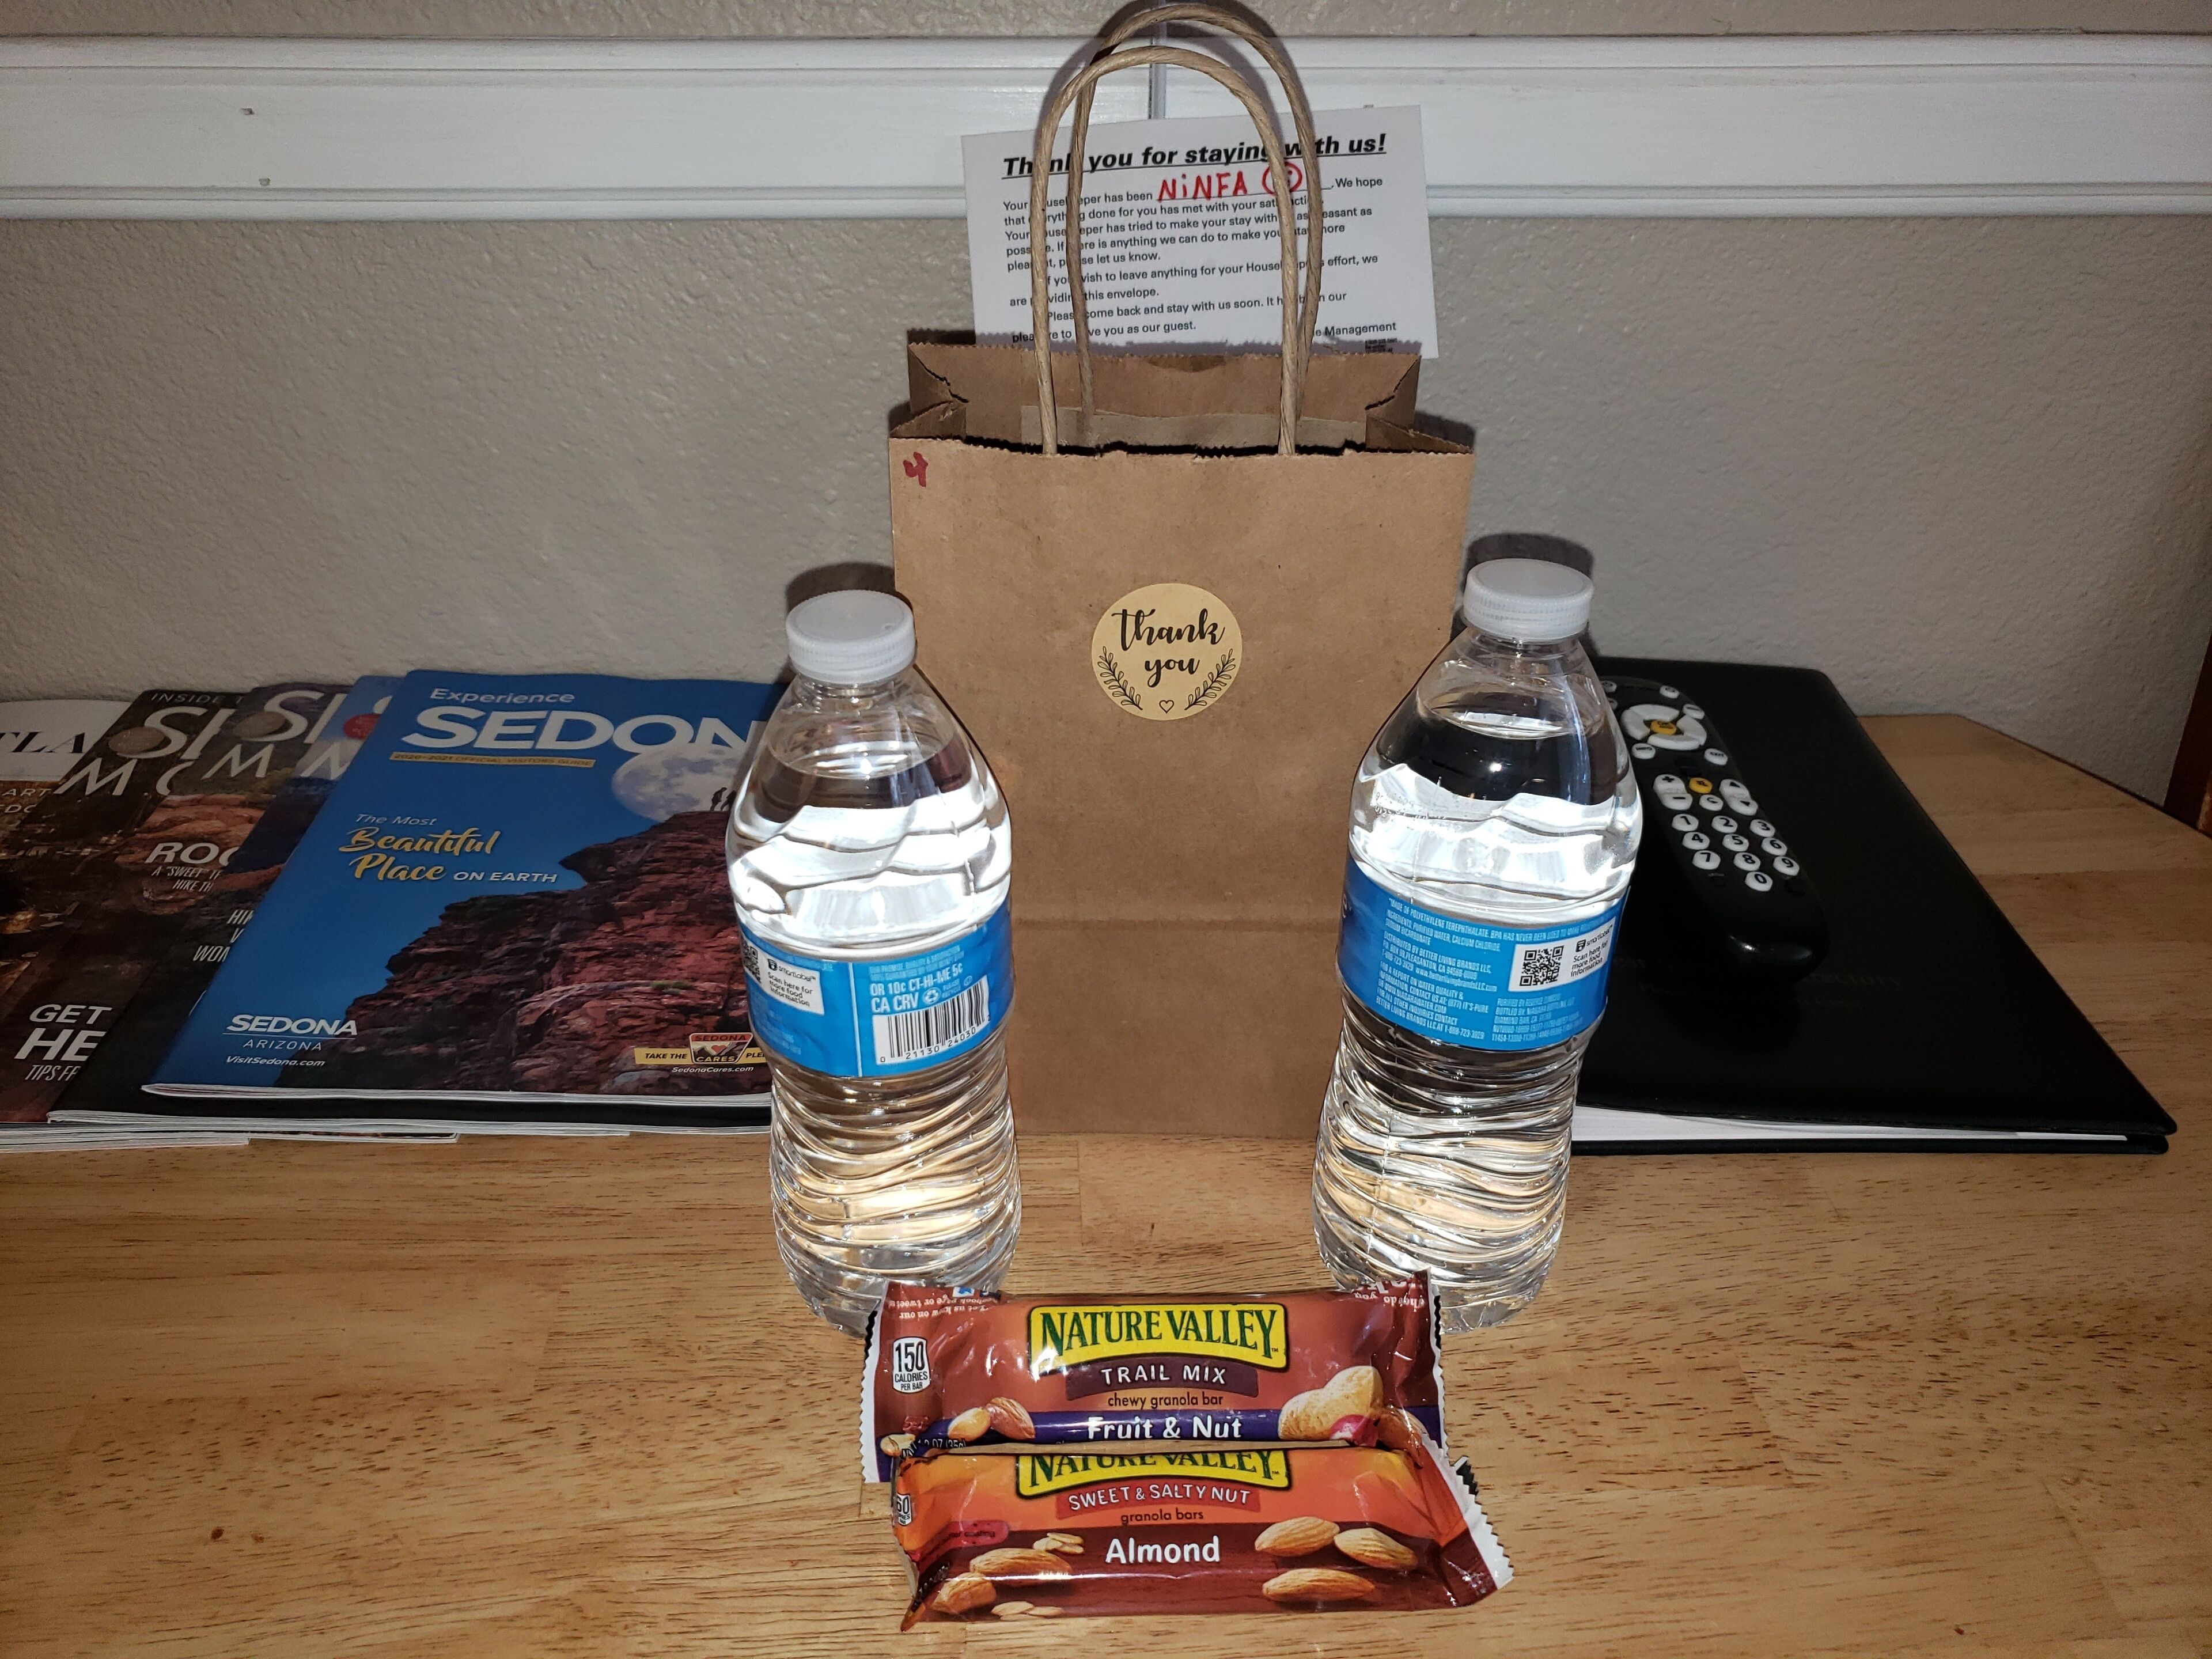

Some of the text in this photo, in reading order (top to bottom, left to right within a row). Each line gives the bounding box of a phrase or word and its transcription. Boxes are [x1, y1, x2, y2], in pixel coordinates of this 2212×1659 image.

[1088, 151, 1133, 173] you
[1141, 146, 1178, 165] for
[1284, 136, 1340, 157] wth
[1348, 133, 1387, 153] us!
[1335, 176, 1383, 188] We hope
[1003, 191, 1153, 211] Your has been
[1004, 201, 1257, 226] that done for you has met with your
[1005, 230, 1030, 241] Your
[1106, 222, 1126, 233] has
[1128, 220, 1153, 232] tried
[1156, 221, 1167, 230] to
[1170, 218, 1199, 229] make
[1201, 219, 1226, 230] your
[1229, 217, 1252, 227] stay
[1254, 213, 1278, 224] with
[1360, 208, 1372, 216] as
[1057, 229, 1261, 252] If is anything we can do to make
[1097, 252, 1161, 264] let us know.
[1105, 255, 1378, 281] to leave anything for your effort, we
[1009, 287, 1160, 306] are this envelope.
[1116, 305, 1141, 316] back
[1143, 303, 1164, 314] and
[1166, 303, 1189, 315] stay
[1191, 301, 1215, 312] with
[1218, 301, 1231, 310] us
[1233, 299, 1264, 309] soon.
[1266, 296, 1274, 306] It
[1328, 293, 1347, 302] our
[1061, 329, 1072, 339] to
[1104, 326, 1124, 338] you
[1127, 326, 1139, 334] as
[1142, 324, 1161, 333] our
[1163, 320, 1196, 334] guest.
[1325, 322, 1396, 337] Management
[1144, 658, 1200, 688] you
[151, 692, 233, 703] INSIDE
[430, 687, 575, 704] Experience
[355, 813, 438, 826] The Most
[1680, 815, 1691, 825] 1
[1719, 817, 1733, 828] 2
[1759, 821, 1771, 831] 3
[339, 827, 502, 855] Beautiful
[1691, 833, 1704, 843] 4
[1731, 835, 1744, 845] 5
[1770, 839, 1782, 849] 6
[1699, 852, 1711, 862] 7
[1742, 854, 1756, 865] 8
[1781, 858, 1794, 869] 9
[347, 853, 558, 884] Place ON EARTH
[172, 878, 198, 892] HIKE
[1753, 873, 1767, 884] 0
[1571, 950, 1601, 970] more food
[1573, 953, 1588, 963] Scan
[1589, 946, 1601, 957] here
[1570, 957, 1603, 978] information
[768, 971, 813, 995] Scan here for
[769, 979, 804, 998] more food
[869, 983, 885, 997] OR
[770, 986, 810, 1007] information
[870, 991, 919, 1014] CA CRV
[28, 1003, 113, 1025] GET
[226, 1014, 358, 1036] SEDONA
[242, 1039, 323, 1051] ARIZONA
[906, 1044, 941, 1060] 21130
[948, 1026, 977, 1047] 24030
[226, 1055, 325, 1067] VisitSedona.com
[24, 1065, 62, 1082] TIPS
[1040, 1309, 1278, 1359] NATURE VALLEY
[894, 1340, 924, 1372] 150
[894, 1372, 929, 1383] CALORIES
[1100, 1366, 1226, 1386] TRAIL MIX
[900, 1382, 923, 1392] PER BAR
[1107, 1391, 1224, 1411] chewy granola bar
[1088, 1416, 1242, 1440] Fruit & Nut
[1068, 1483, 1251, 1511] SWEET & SALTY NUT
[1120, 1508, 1204, 1525] granola bars
[1105, 1535, 1221, 1565] Almond
